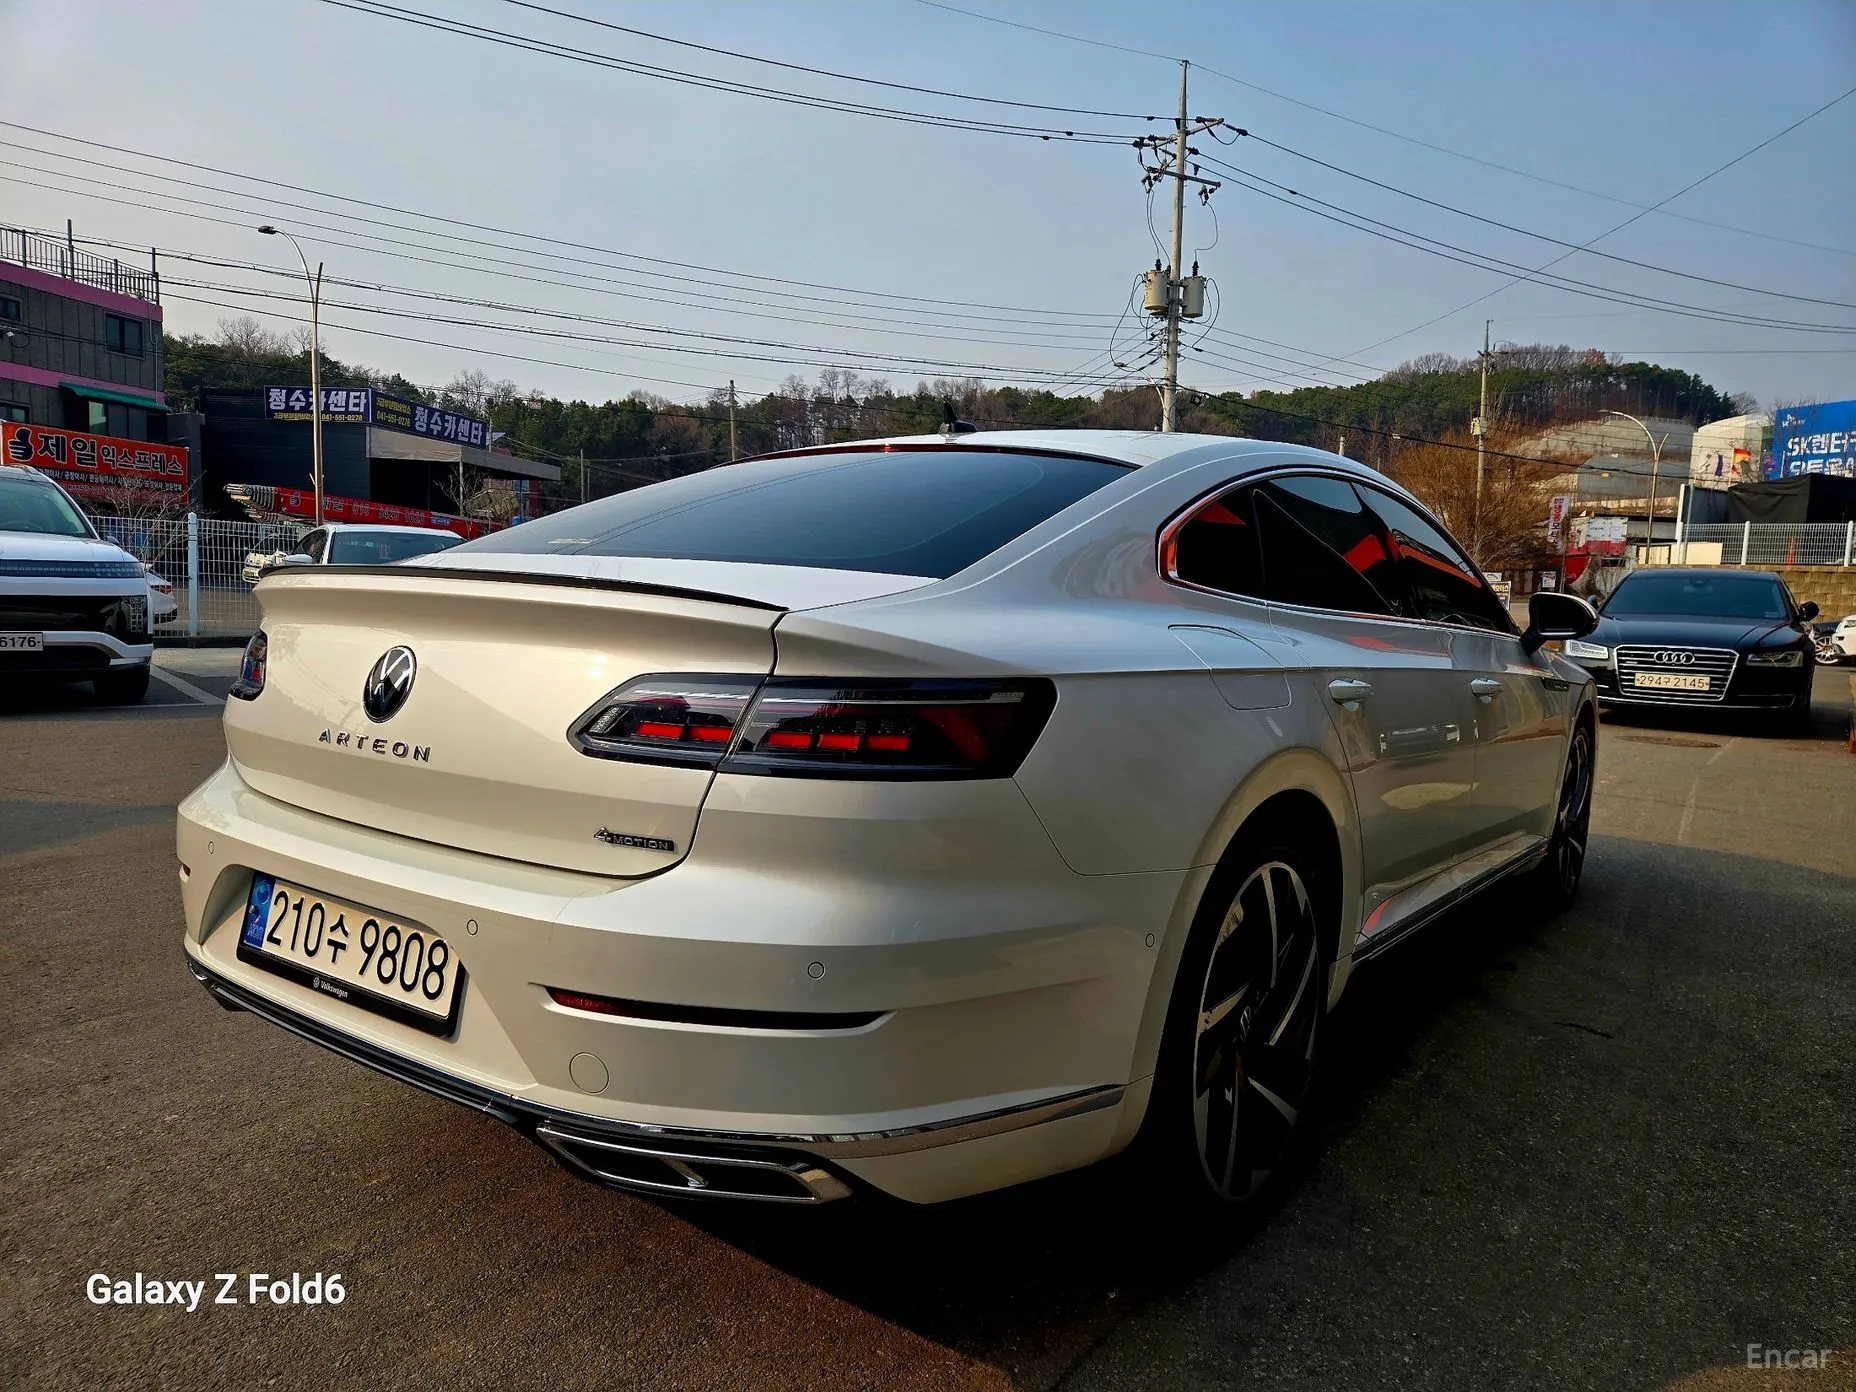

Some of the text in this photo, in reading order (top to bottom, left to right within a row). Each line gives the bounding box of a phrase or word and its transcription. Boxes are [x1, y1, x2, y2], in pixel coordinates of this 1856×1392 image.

[414, 406, 483, 445] 청수카센타
[37, 433, 184, 475] 제일 익스프레스
[0, 636, 37, 648] 6176
[1673, 678, 1705, 688] 2145
[318, 728, 432, 763] ARTEON
[358, 918, 450, 1001] 9808
[320, 979, 348, 998] Volkswagen
